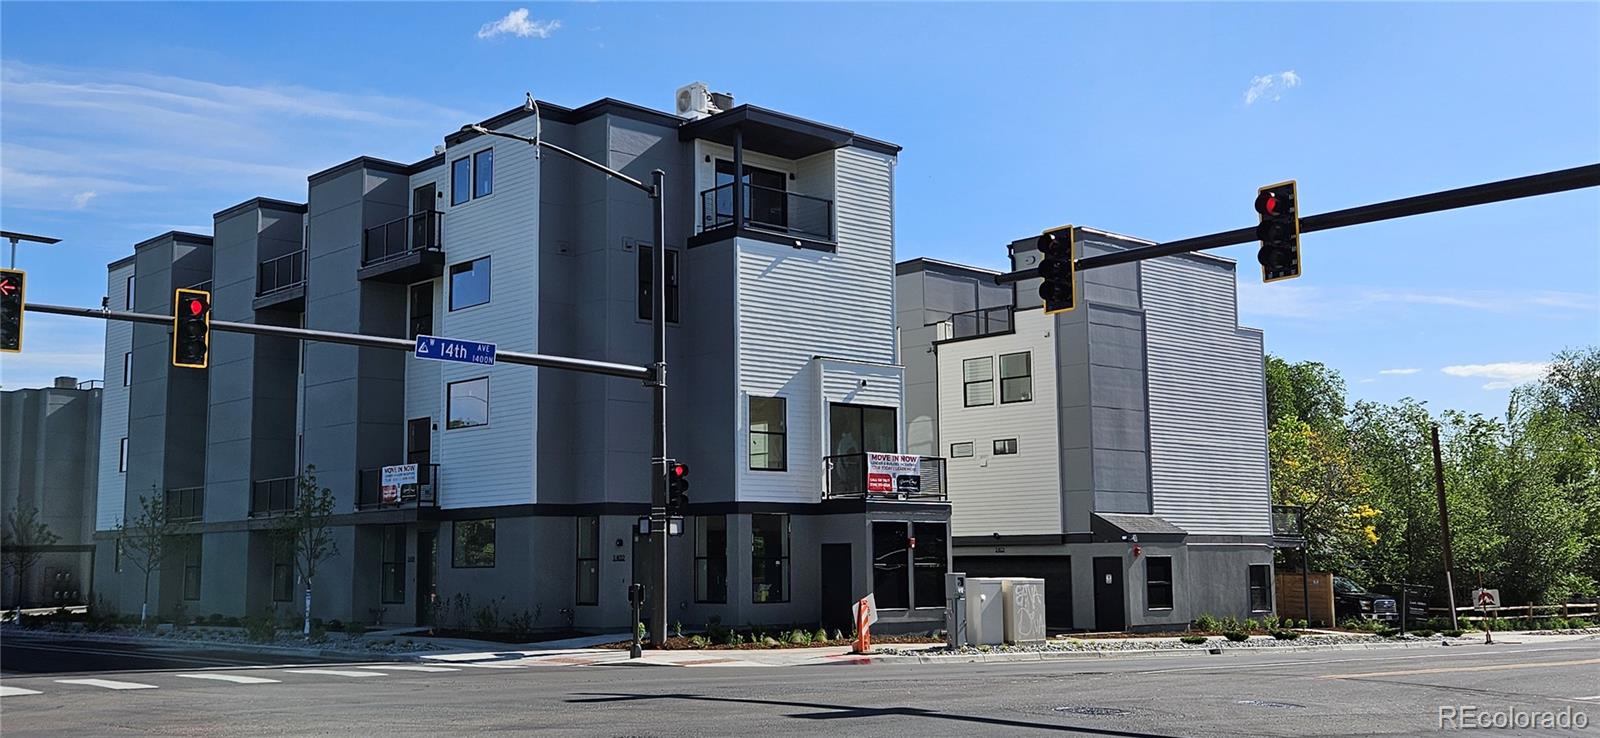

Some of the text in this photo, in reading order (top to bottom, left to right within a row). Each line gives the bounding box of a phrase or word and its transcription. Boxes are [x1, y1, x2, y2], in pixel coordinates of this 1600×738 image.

[440, 342, 467, 359] 14th
[477, 344, 490, 353] AVE
[472, 355, 493, 364] 1400N
[871, 454, 890, 462] MOVE
